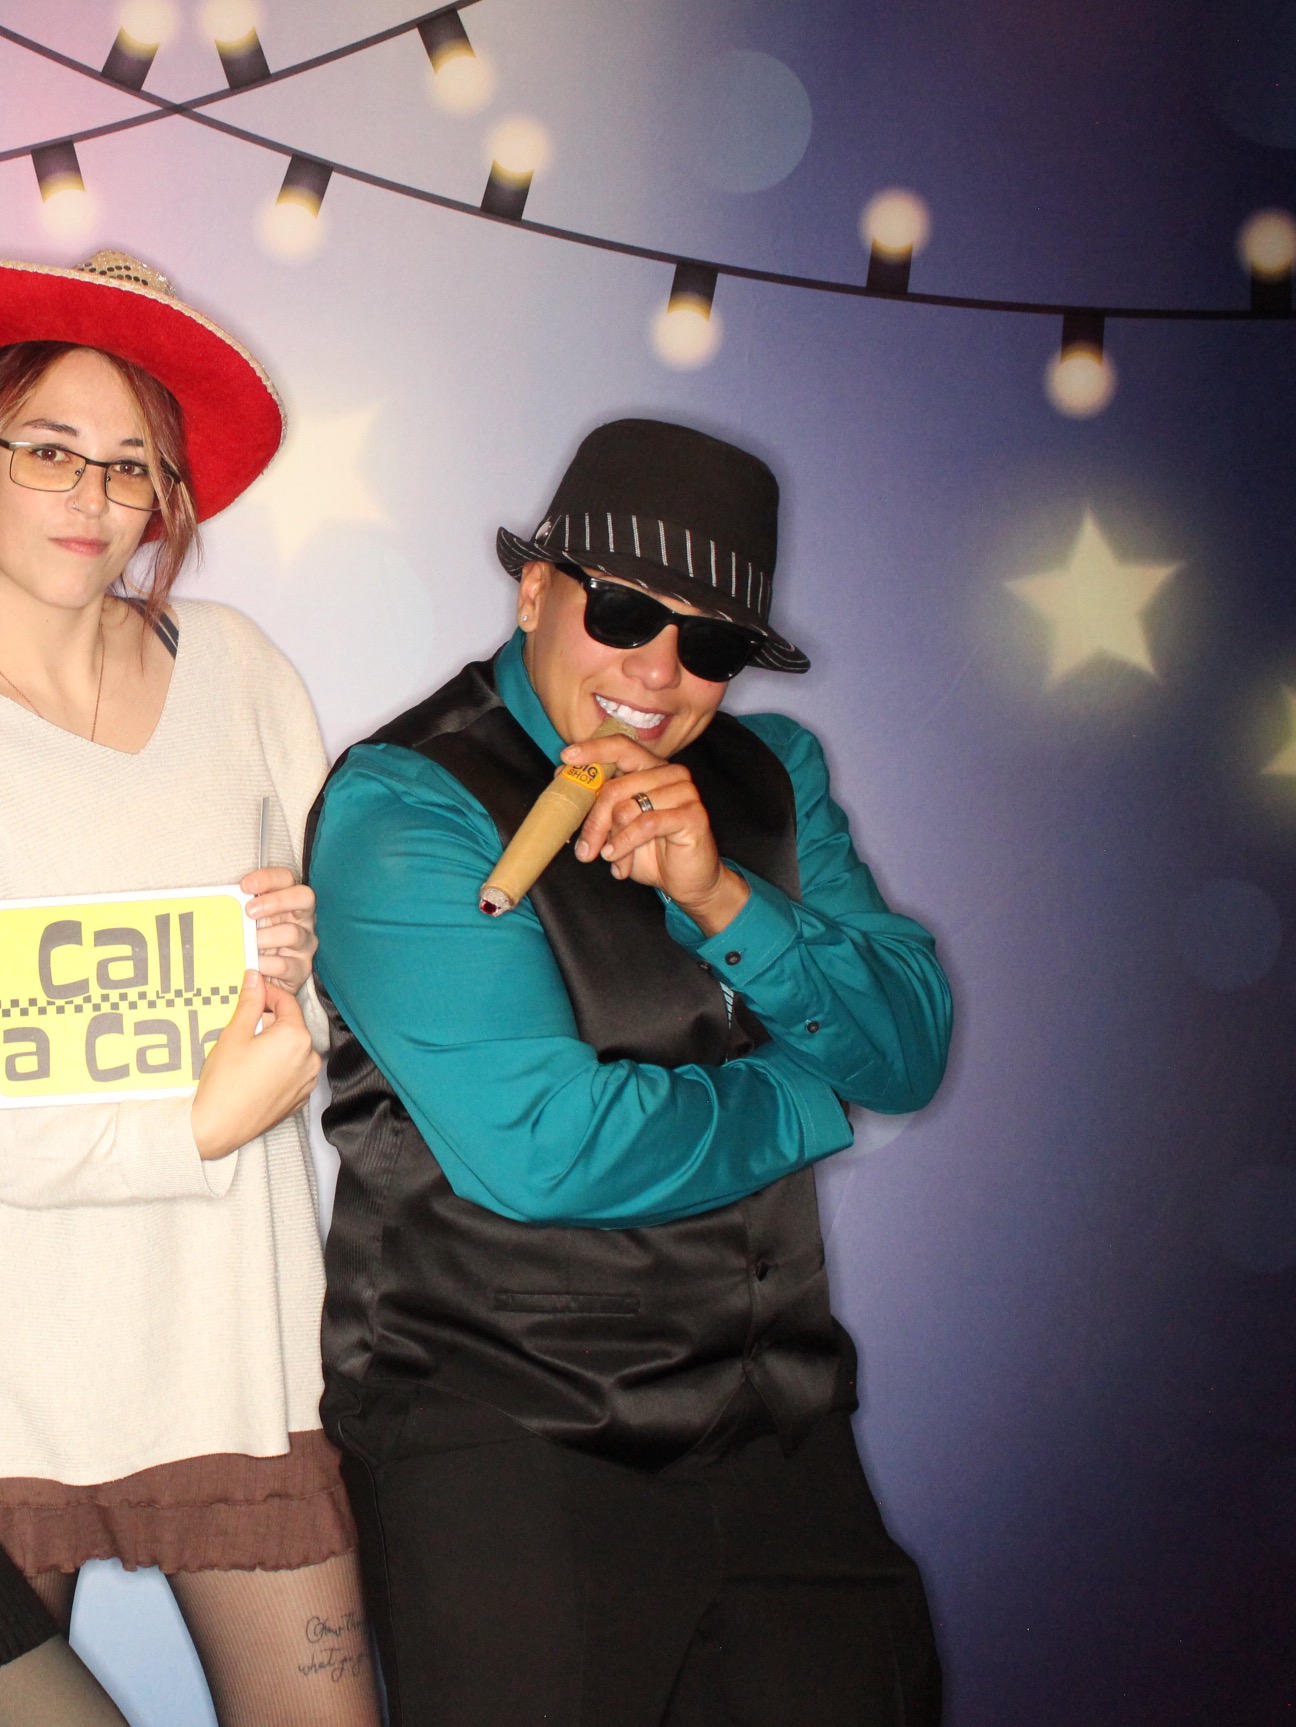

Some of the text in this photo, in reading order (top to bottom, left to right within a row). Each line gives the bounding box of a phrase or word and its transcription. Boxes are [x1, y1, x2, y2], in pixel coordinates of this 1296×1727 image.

[568, 769, 593, 784] SHOT
[39, 911, 194, 999] Call
[3, 1027, 50, 1082] a
